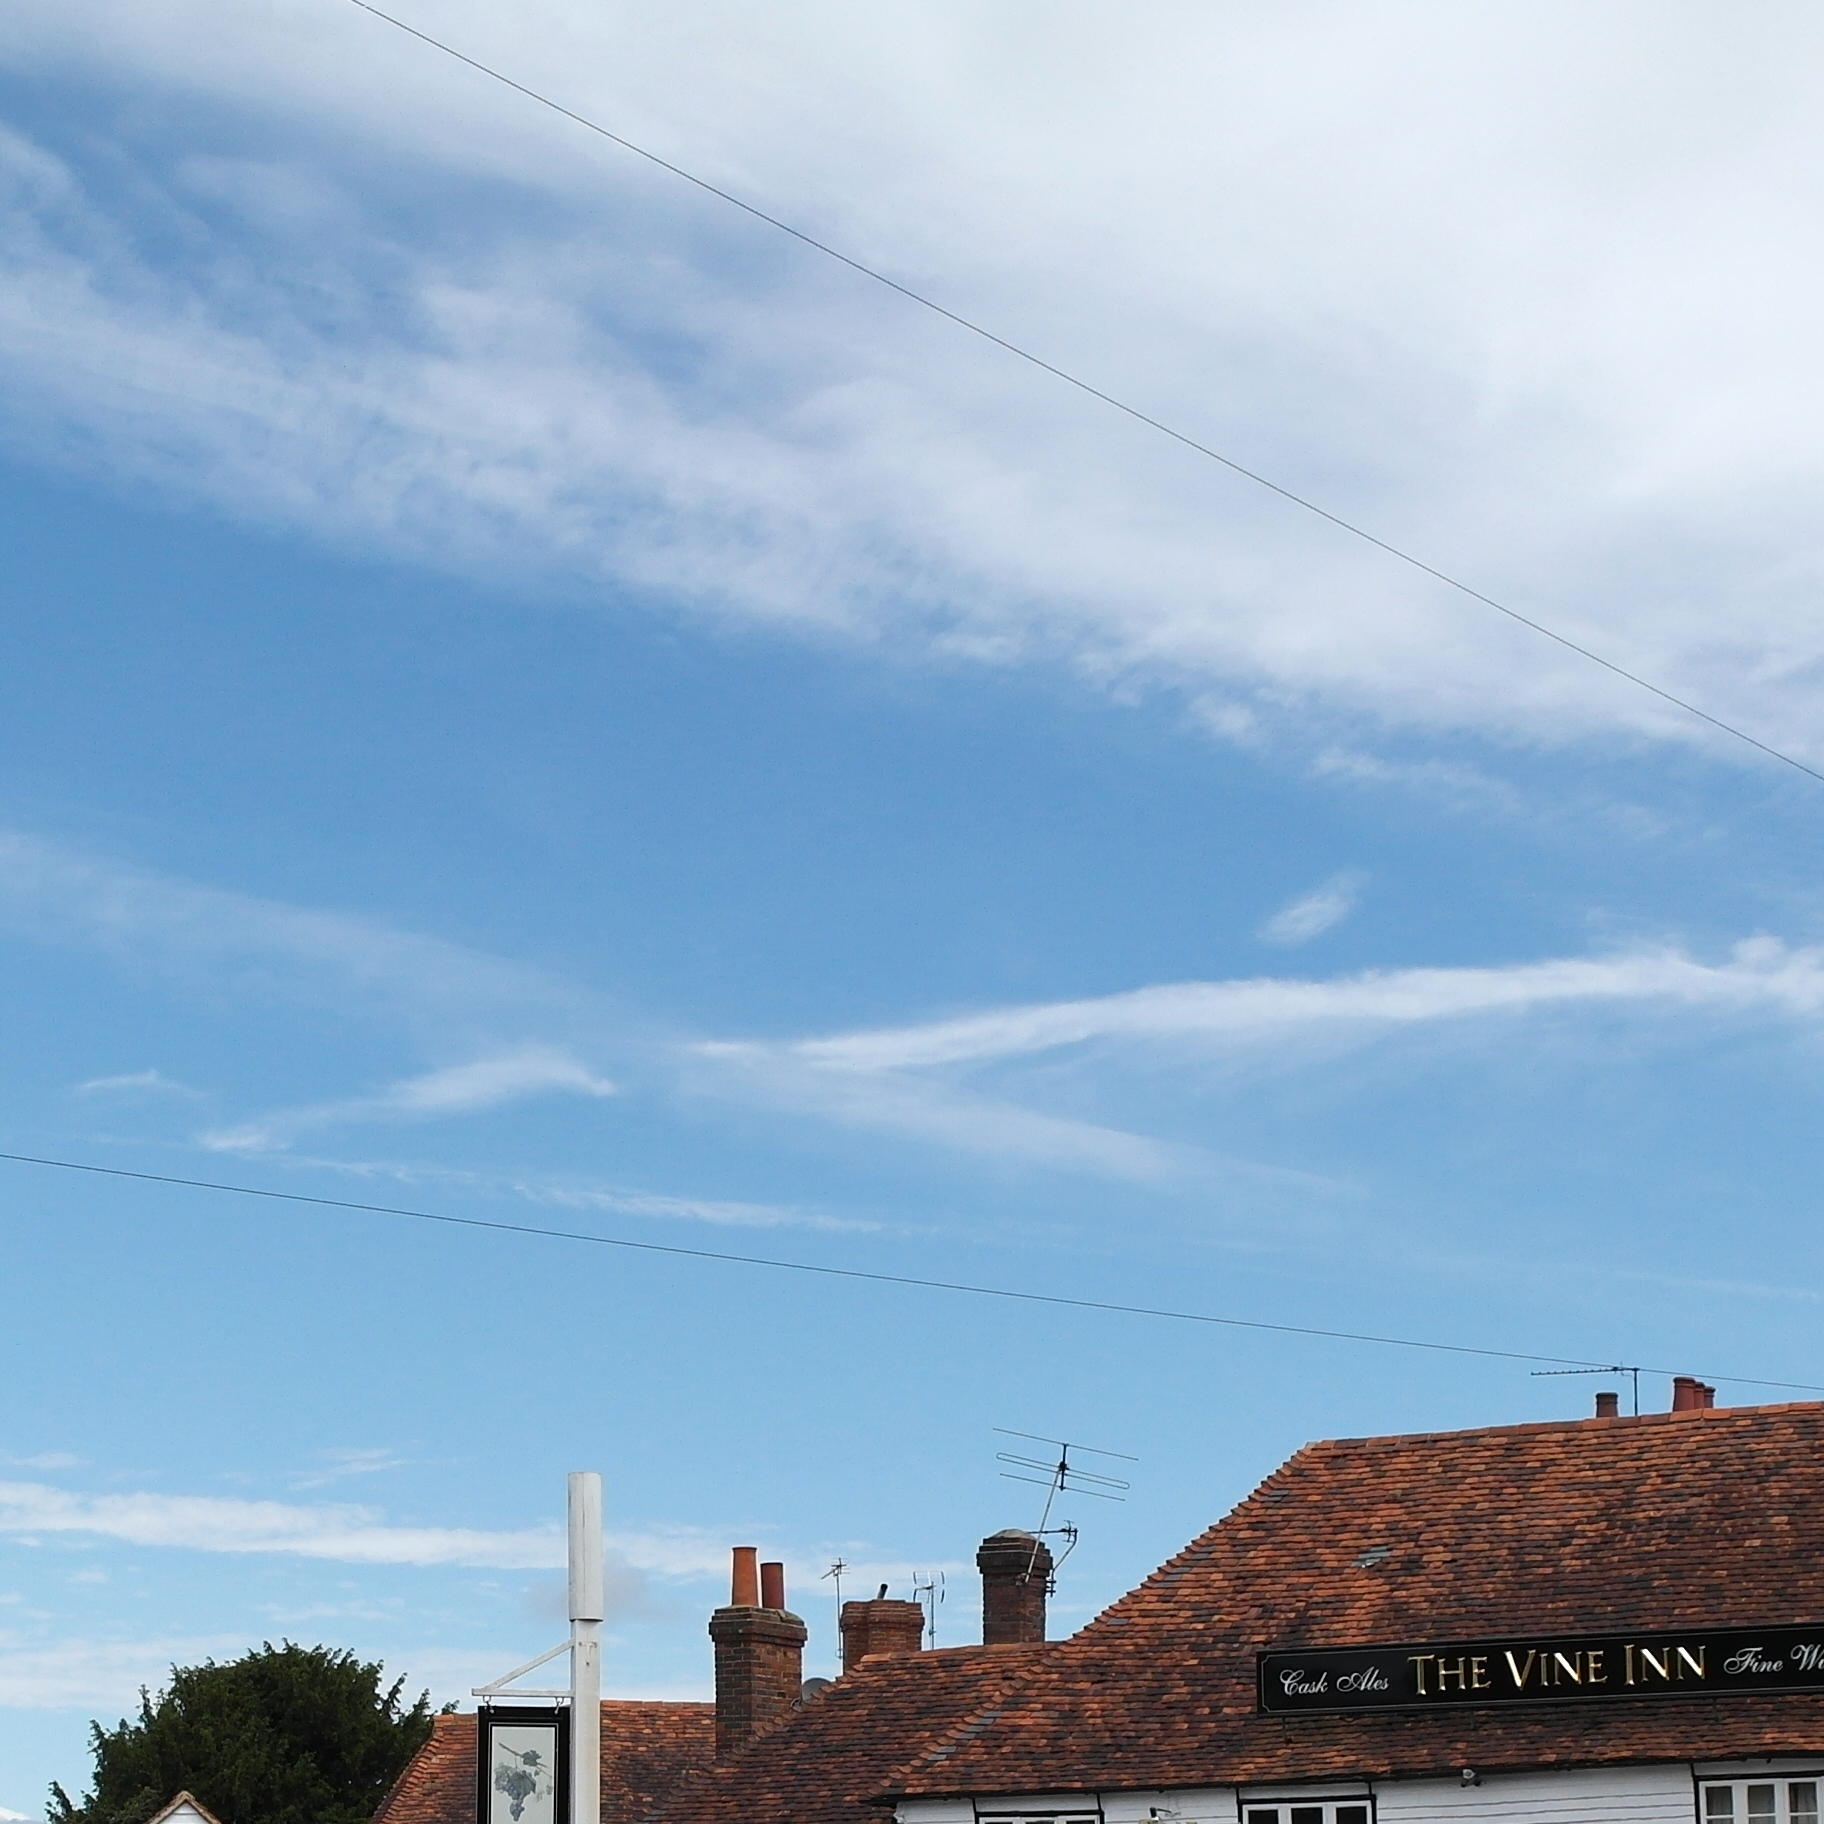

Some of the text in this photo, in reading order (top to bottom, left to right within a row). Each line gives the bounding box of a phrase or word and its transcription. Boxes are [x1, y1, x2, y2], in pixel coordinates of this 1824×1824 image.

[1279, 1669, 1328, 1697] Cask
[1336, 1666, 1389, 1693] Ales
[1407, 1654, 1491, 1696] THE
[1503, 1649, 1608, 1692] VINE
[1623, 1644, 1706, 1686] INN
[1723, 1646, 1784, 1674] Fine
